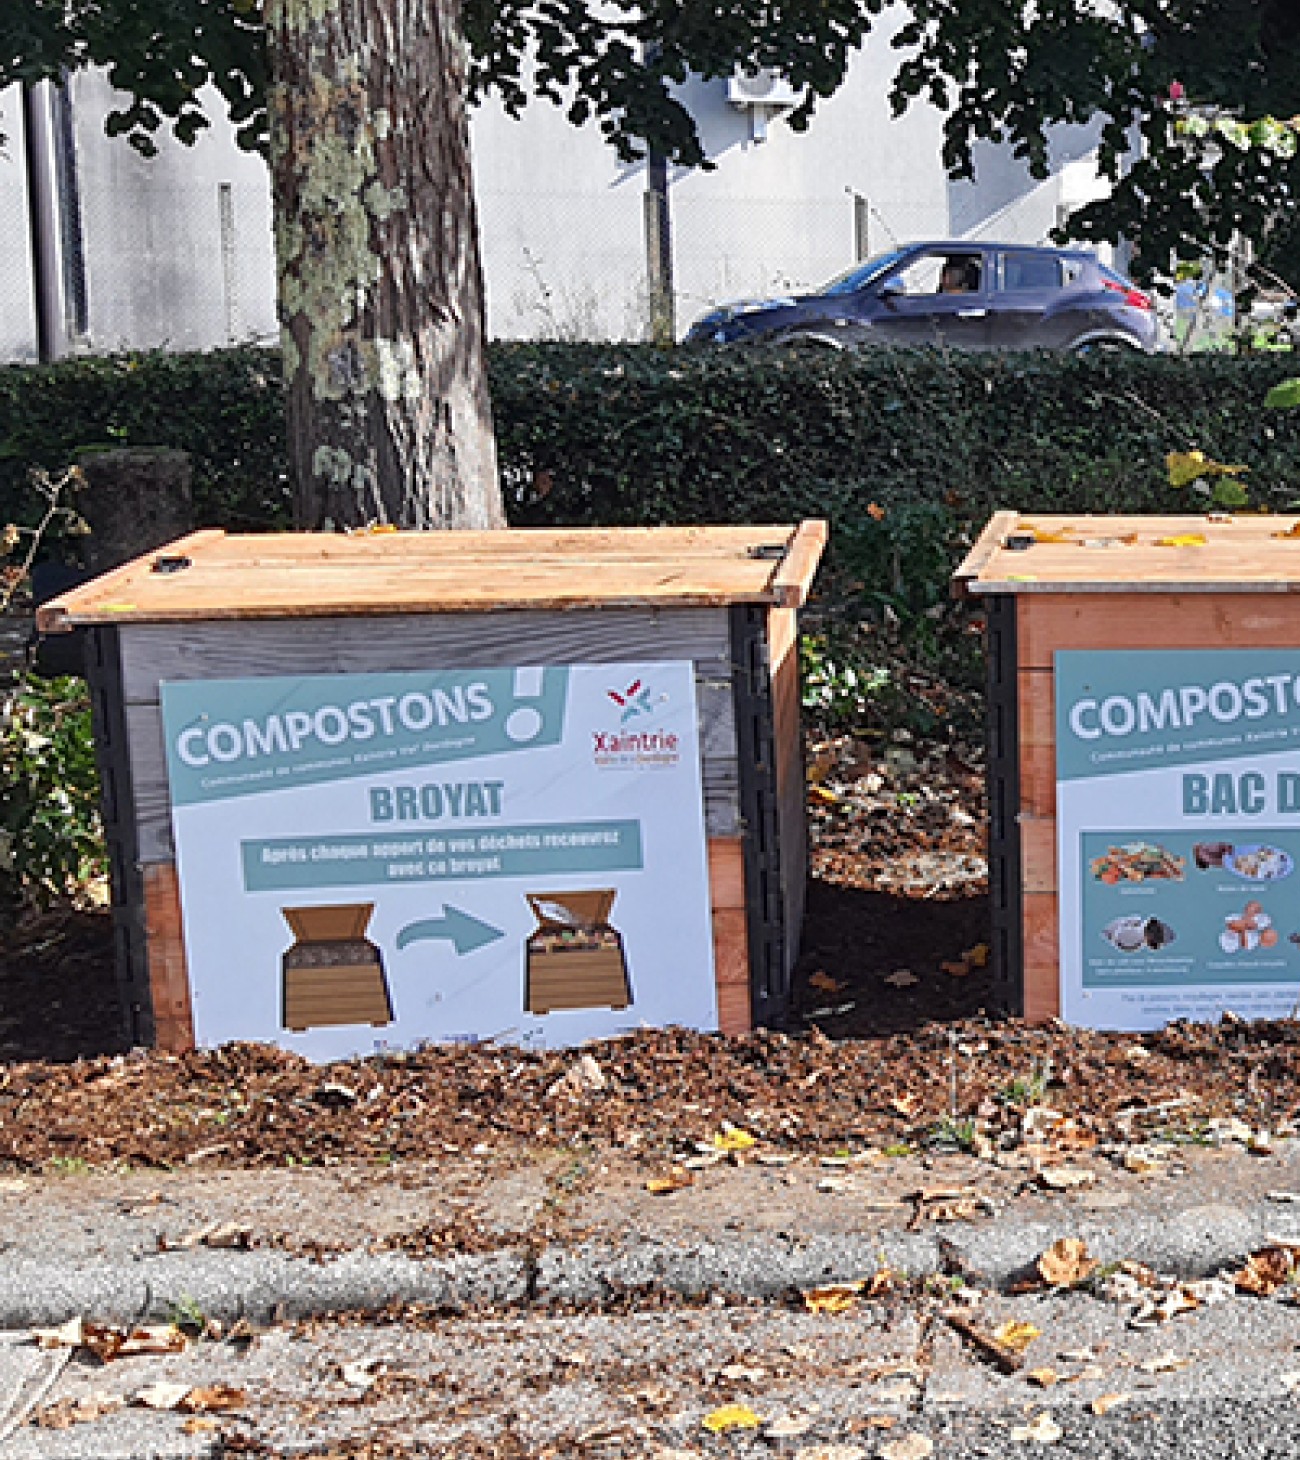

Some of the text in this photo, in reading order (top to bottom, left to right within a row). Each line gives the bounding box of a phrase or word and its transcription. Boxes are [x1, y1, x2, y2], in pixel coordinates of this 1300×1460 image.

[177, 666, 544, 766] COMPOSTONS !
[592, 728, 679, 752] Xaintrie
[370, 780, 504, 822] BROYAT
[1183, 773, 1265, 813] BAC
[262, 829, 619, 865] Après chaque apport de vos déchets recouvrez
[388, 855, 501, 878] avec ce broyat
